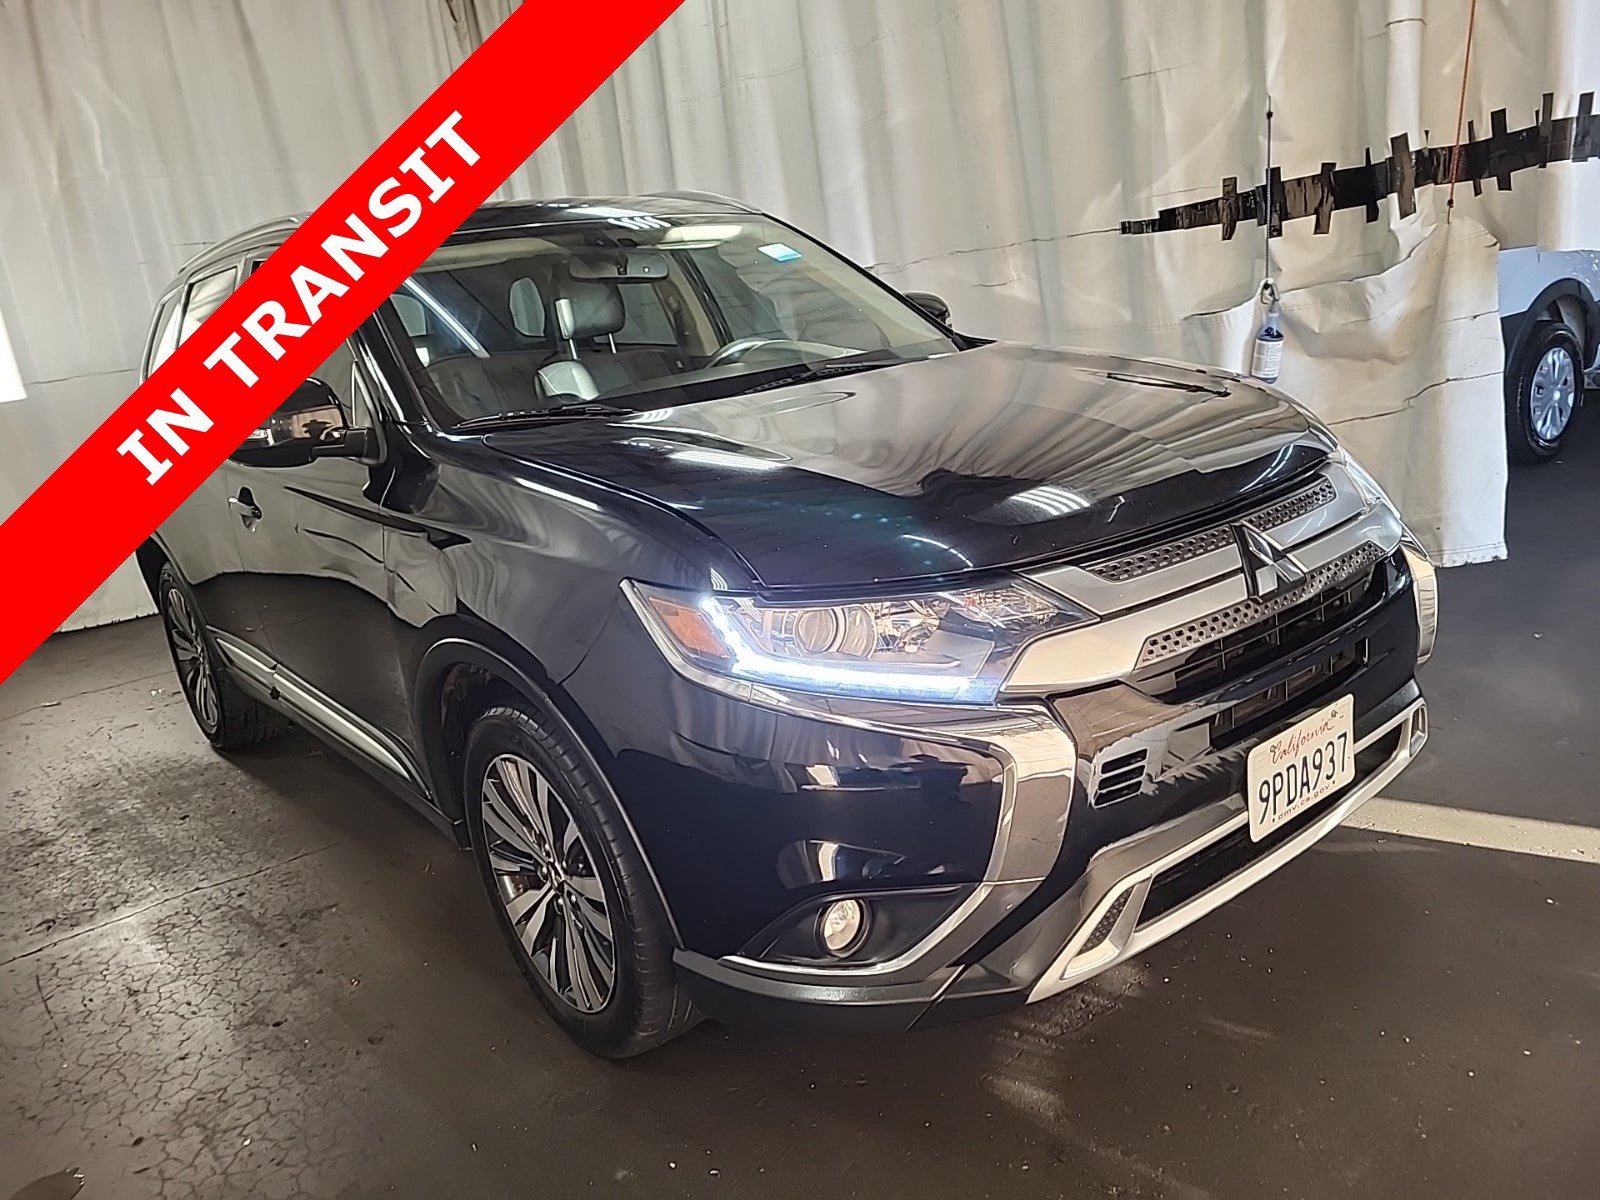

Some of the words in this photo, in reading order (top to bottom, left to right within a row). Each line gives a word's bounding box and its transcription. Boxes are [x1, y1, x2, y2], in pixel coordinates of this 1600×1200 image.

[1269, 718, 1336, 765] California
[1258, 731, 1348, 825] 9PDA937
[1277, 783, 1331, 821] dmv.ca.gov
